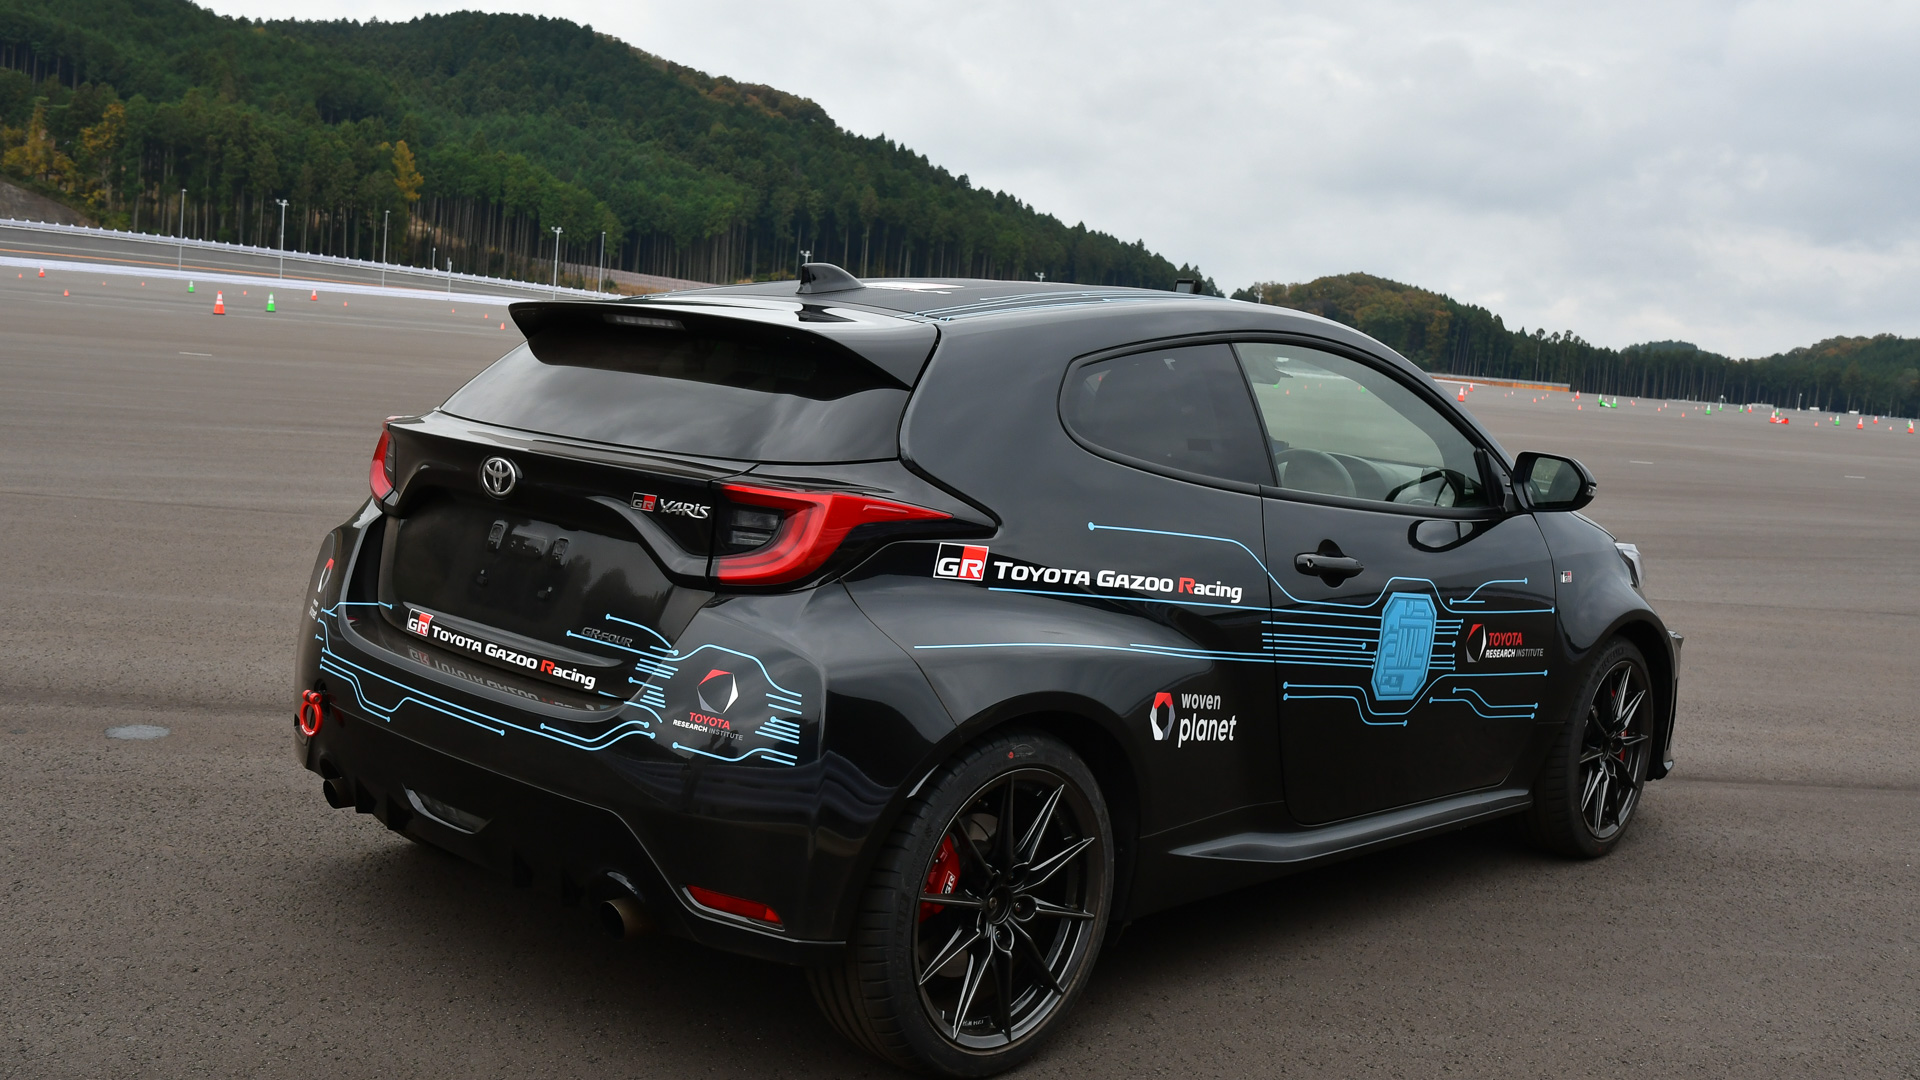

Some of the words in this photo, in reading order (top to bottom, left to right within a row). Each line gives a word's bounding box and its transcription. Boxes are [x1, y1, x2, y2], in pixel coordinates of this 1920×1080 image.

[993, 561, 1090, 586] TOYOTA
[1096, 570, 1173, 593] GAZOO
[1178, 577, 1242, 604] Racing
[1489, 632, 1523, 646] TOYOTA
[432, 625, 482, 652] TOYOTA
[485, 643, 537, 670] GAZOO
[540, 659, 596, 690] Racing
[1485, 648, 1516, 659] RESEARCH
[1516, 648, 1544, 657] INSTITUTE
[1181, 693, 1221, 710] woven
[672, 719, 708, 732] RESEARCH
[708, 728, 744, 741] INSTITUTE
[689, 712, 731, 730] TOYOTA
[1177, 712, 1237, 748] planet
